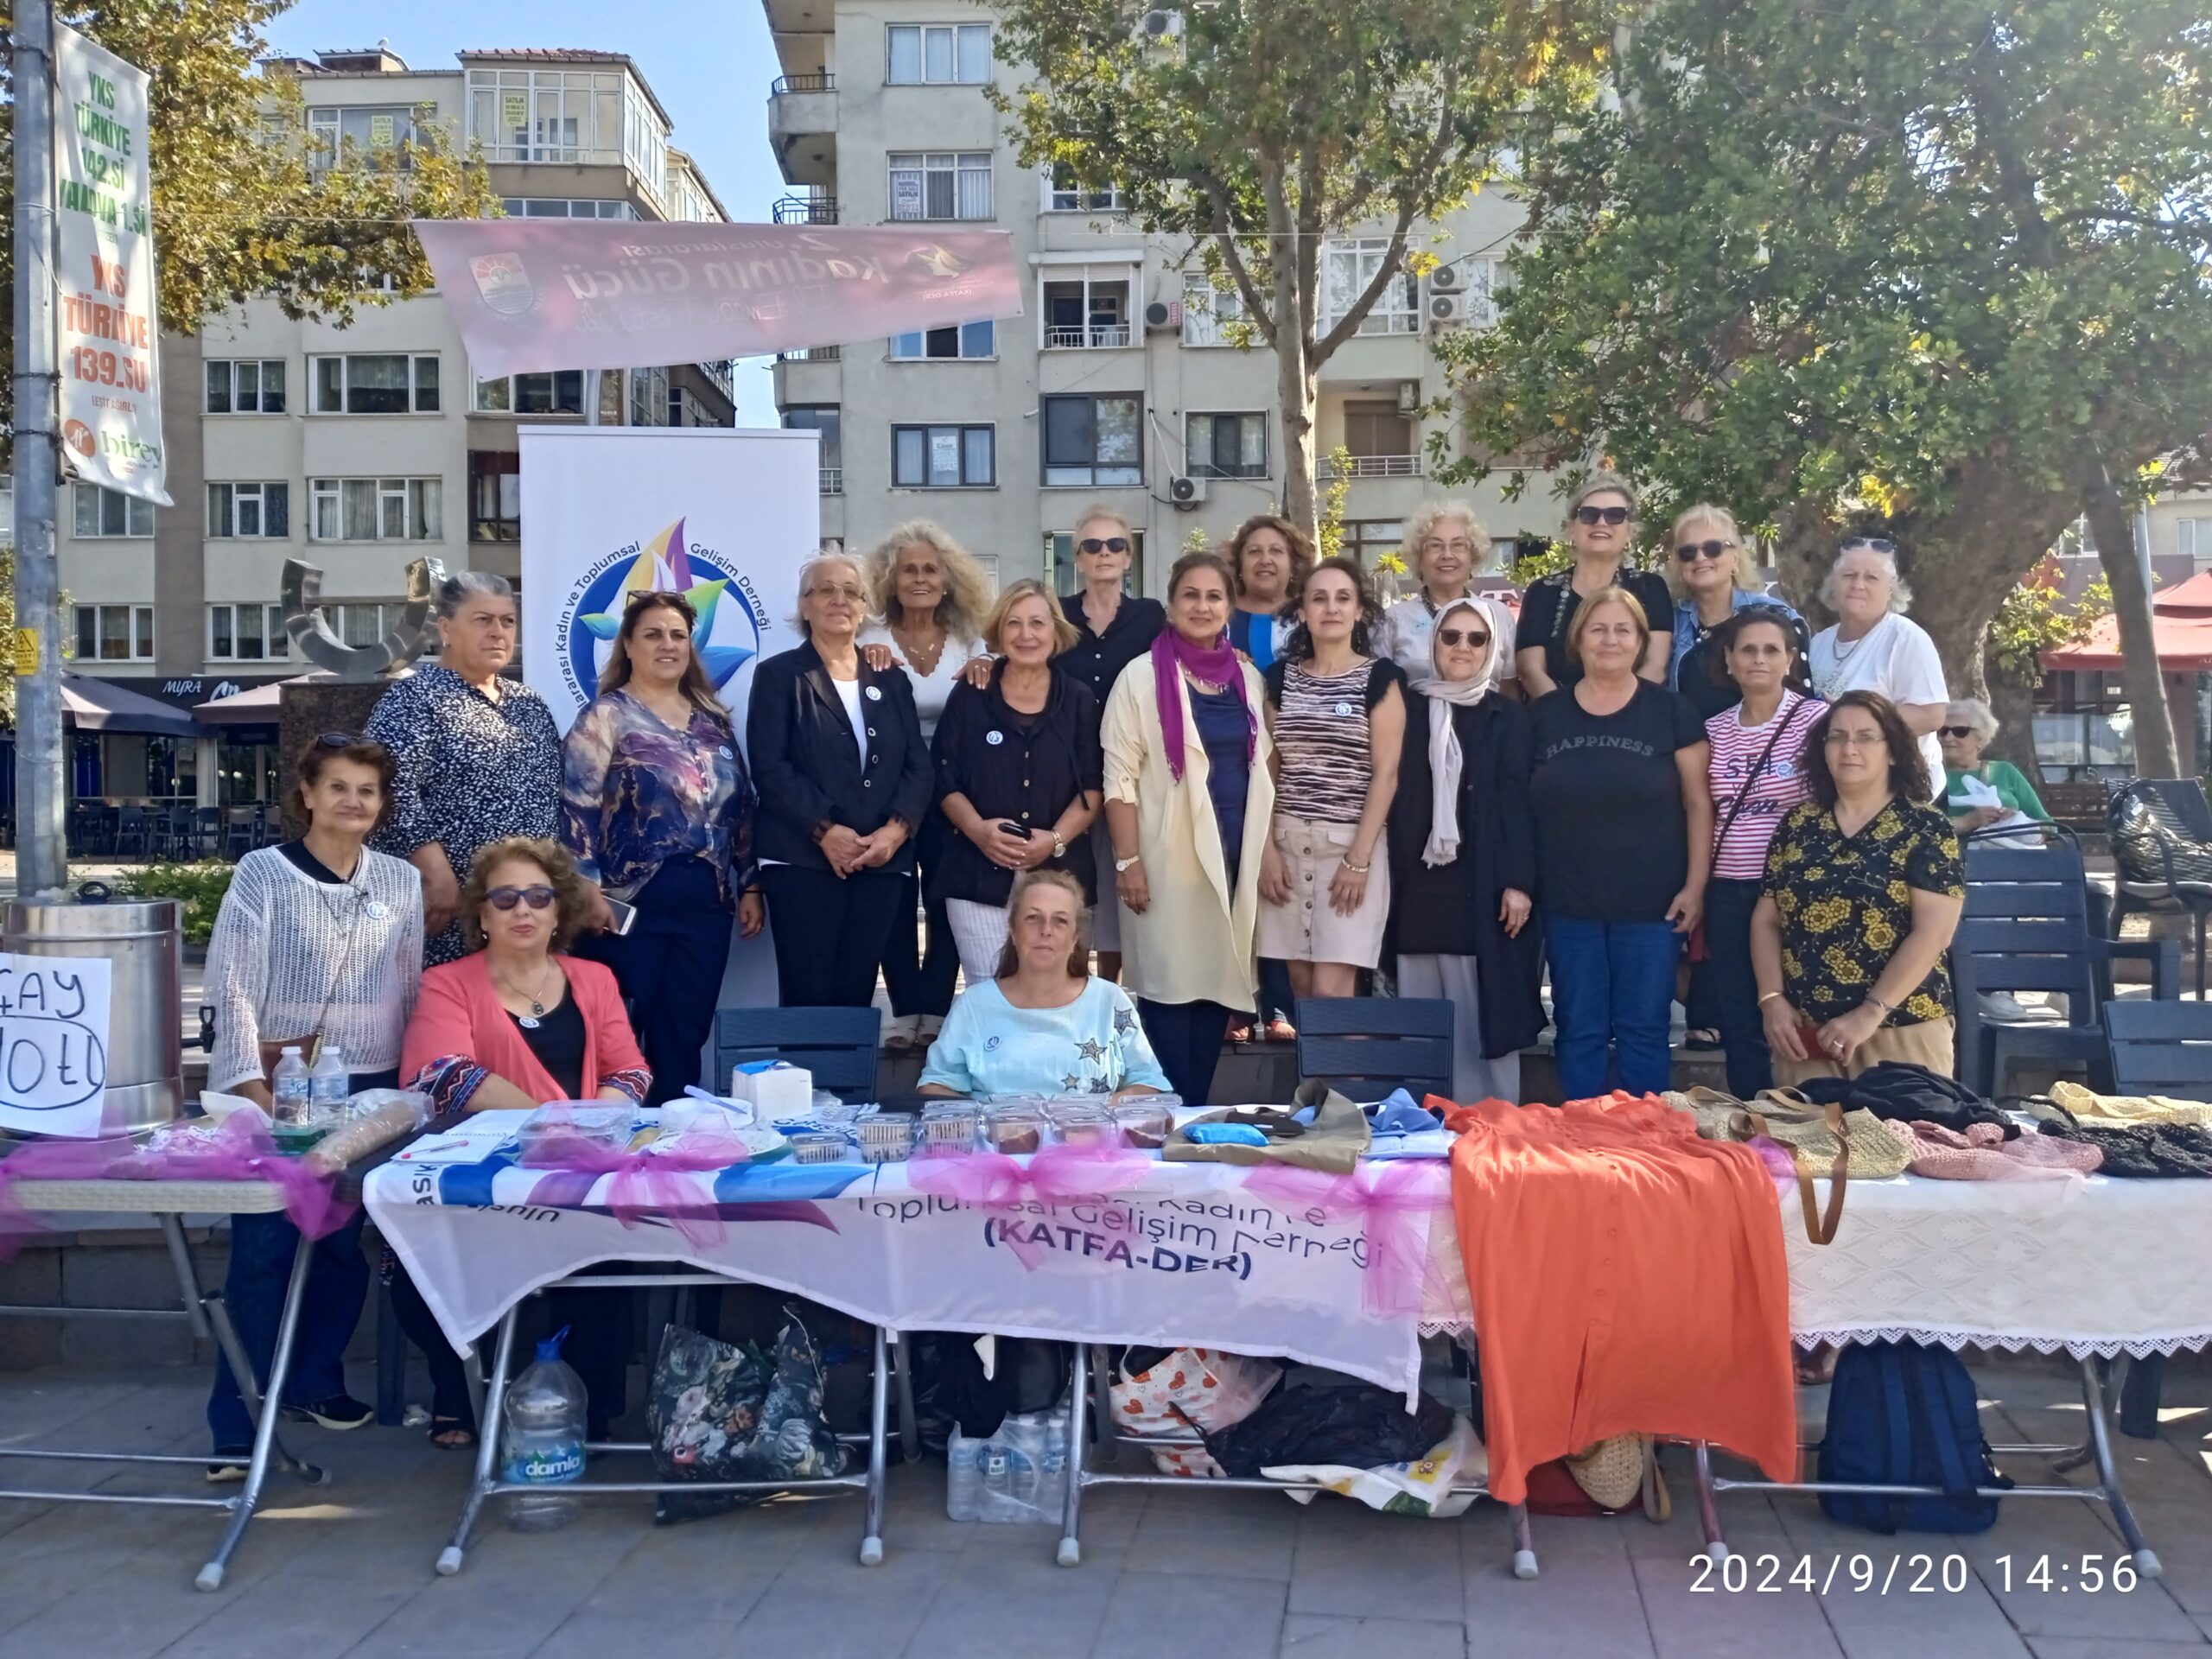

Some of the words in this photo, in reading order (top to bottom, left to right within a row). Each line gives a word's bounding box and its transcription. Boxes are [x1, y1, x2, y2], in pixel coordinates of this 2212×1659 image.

[88, 71, 115, 111] YKS
[73, 100, 130, 156] TÜRKİYE
[63, 291, 149, 350] TÜRKİYE
[575, 541, 641, 590] Toplumsal
[690, 543, 739, 577] Gelişim
[565, 591, 580, 609] ve
[737, 575, 772, 632] Derneği
[556, 610, 571, 652] Kadın
[559, 655, 589, 709] lararası
[1546, 734, 1654, 760] HAPPINESS
[984, 1217, 1251, 1281] (KATFA-DER)
[1071, 1201, 1217, 1251] Gelişim
[525, 1456, 581, 1477] damla
